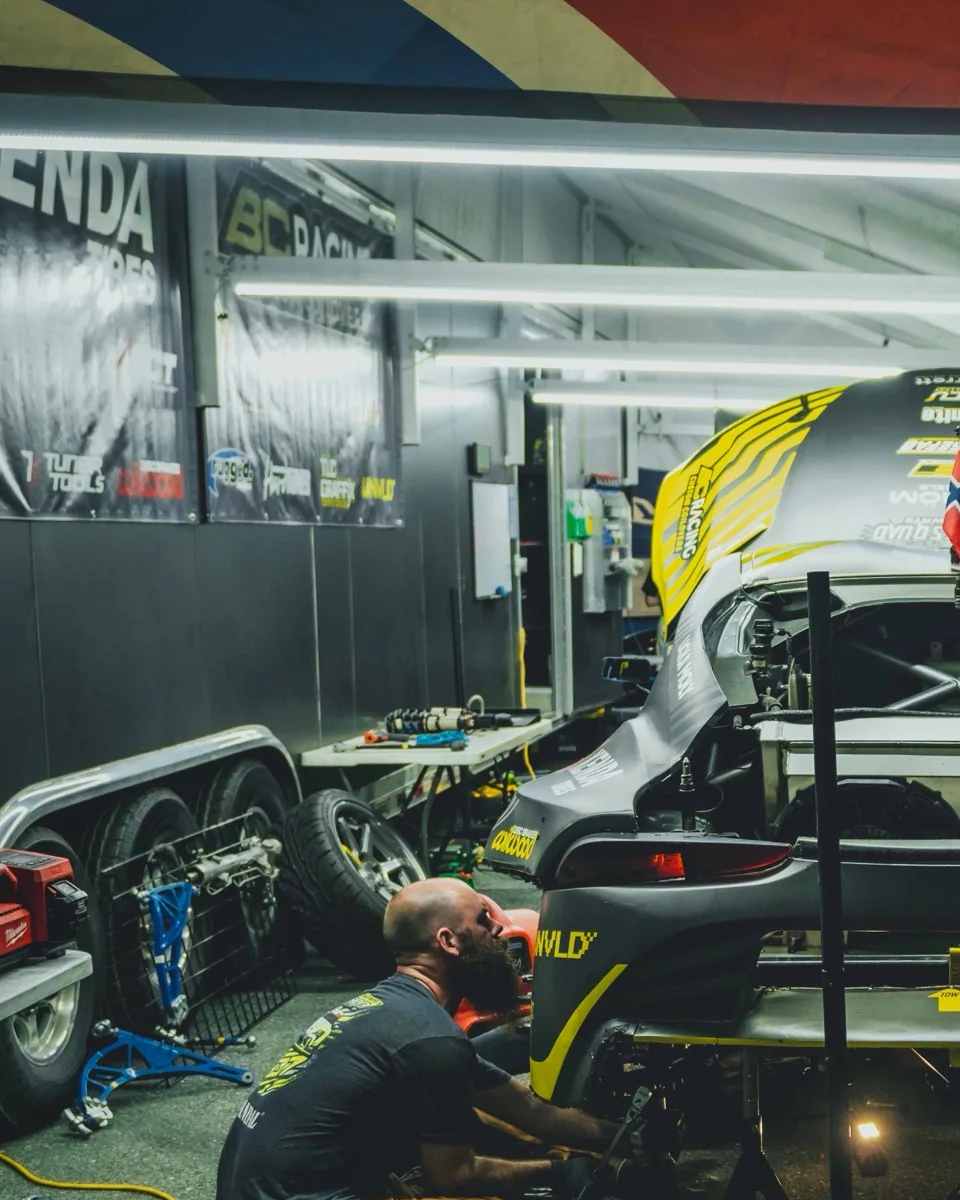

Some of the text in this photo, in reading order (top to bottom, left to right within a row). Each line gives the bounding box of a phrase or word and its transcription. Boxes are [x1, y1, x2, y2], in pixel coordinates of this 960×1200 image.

[43, 451, 104, 476] TUNER
[49, 471, 106, 494] TOOLS
[682, 497, 706, 560] RACING
